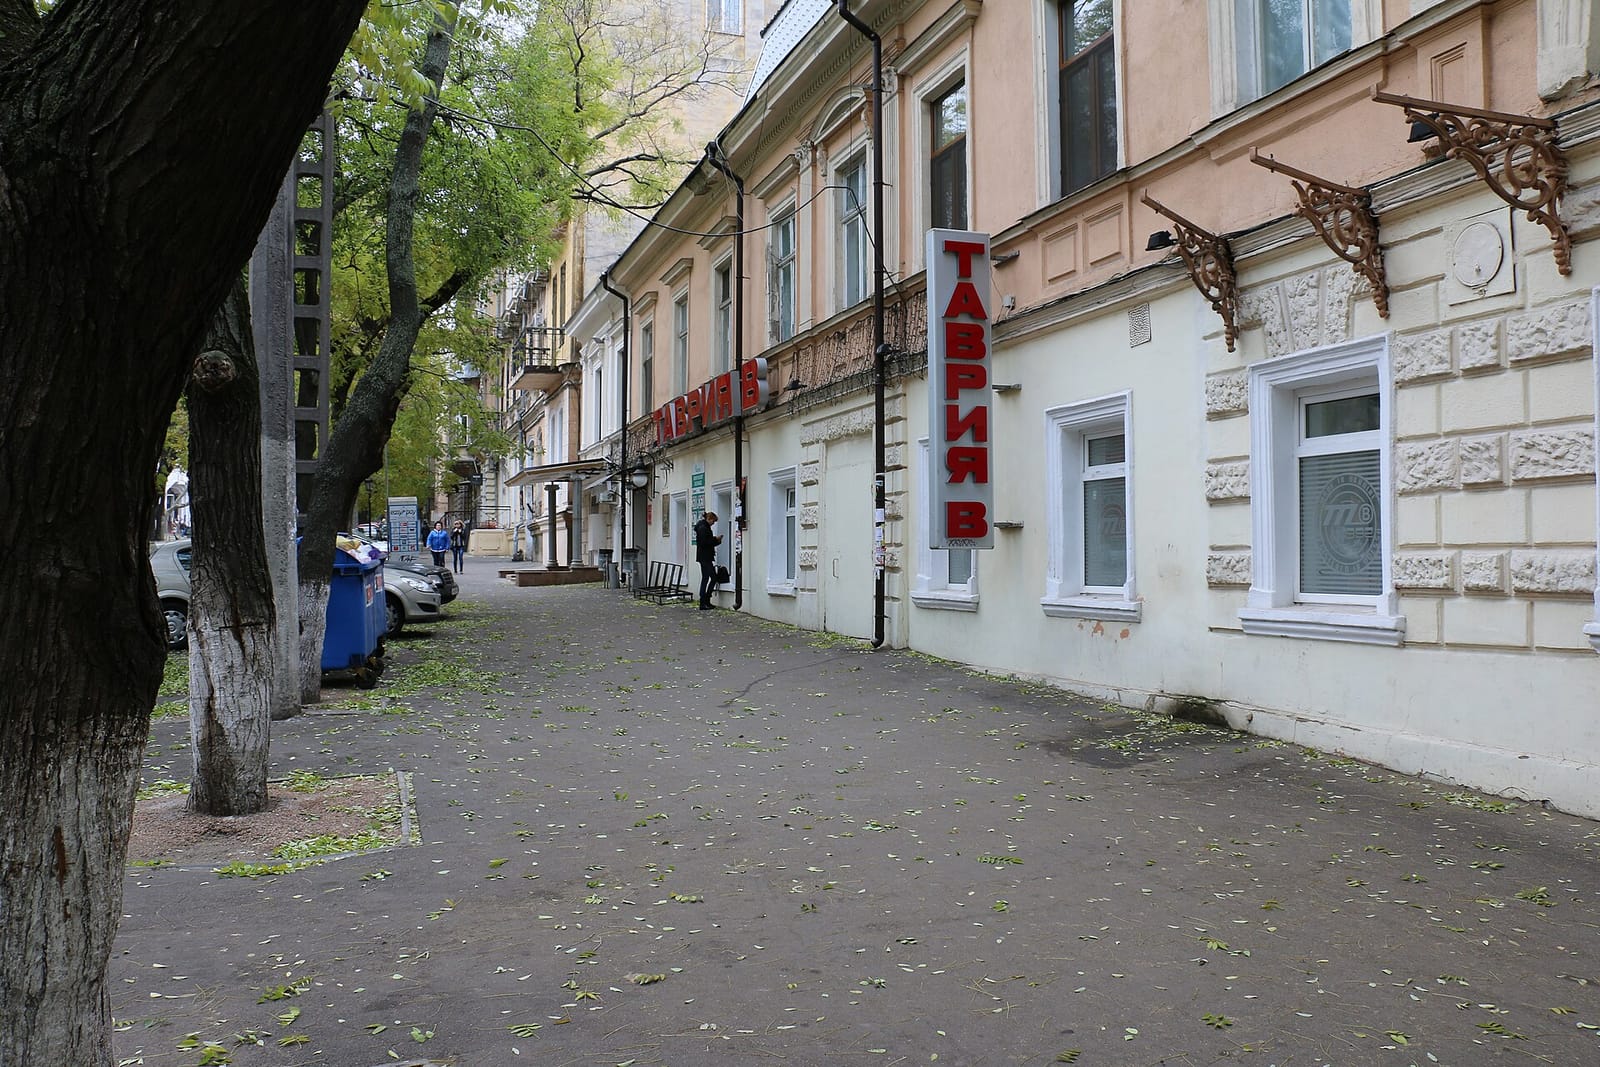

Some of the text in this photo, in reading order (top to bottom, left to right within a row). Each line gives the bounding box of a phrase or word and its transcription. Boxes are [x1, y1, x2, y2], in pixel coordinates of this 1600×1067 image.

[652, 358, 765, 447] ТАВРИЯ В
[943, 240, 988, 484] ТАВРИЯ
[945, 501, 988, 539] В
